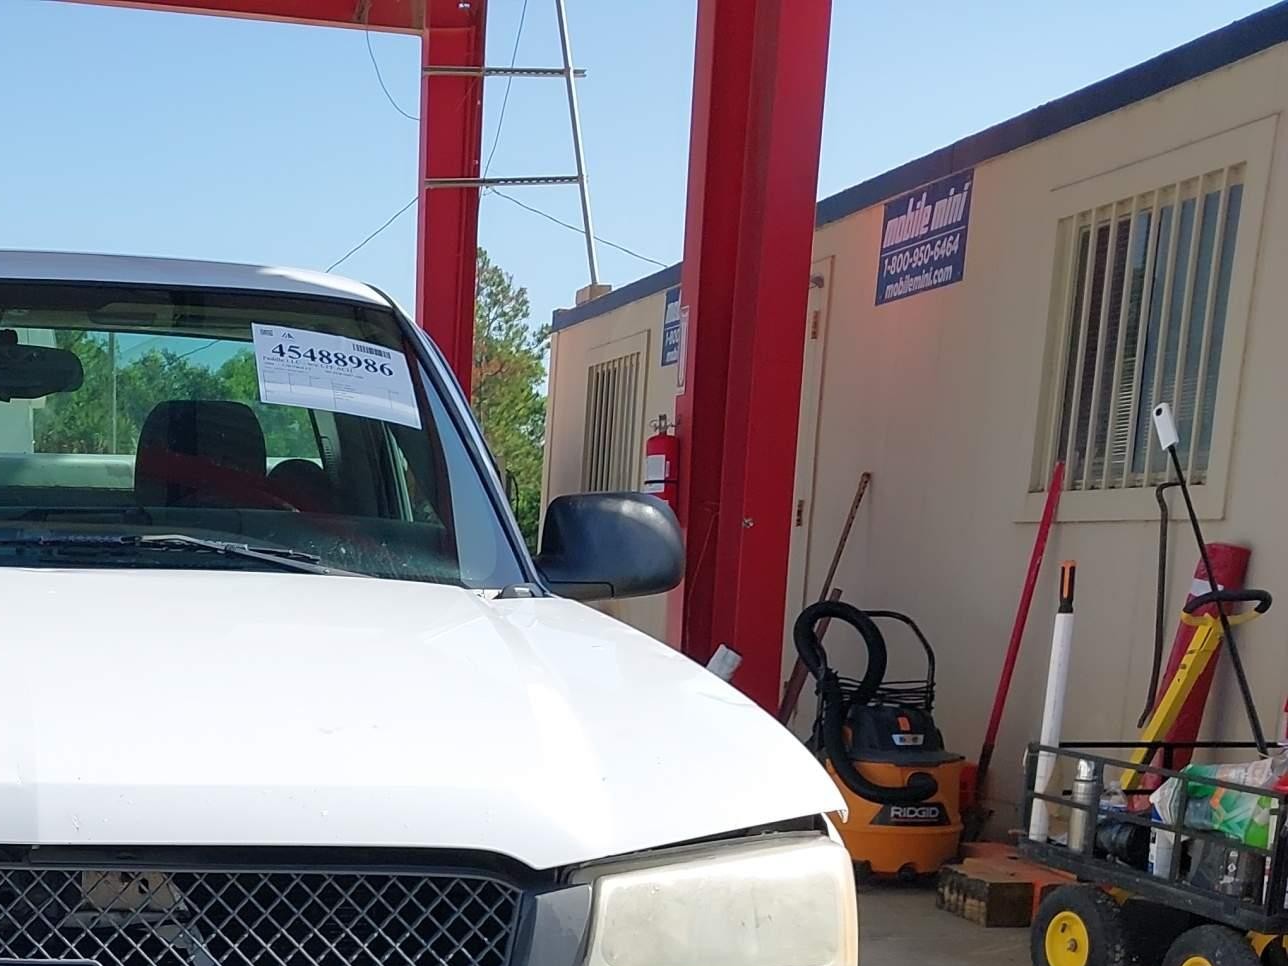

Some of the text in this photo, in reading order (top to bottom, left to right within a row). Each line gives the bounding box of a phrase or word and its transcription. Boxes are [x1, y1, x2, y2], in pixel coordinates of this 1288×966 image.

[883, 181, 971, 249] mobile mini
[883, 233, 960, 278] 1-800-950-6464
[884, 265, 953, 299] mobilemini.com
[272, 343, 394, 377] 45488986
[890, 806, 940, 818] RIDGID
